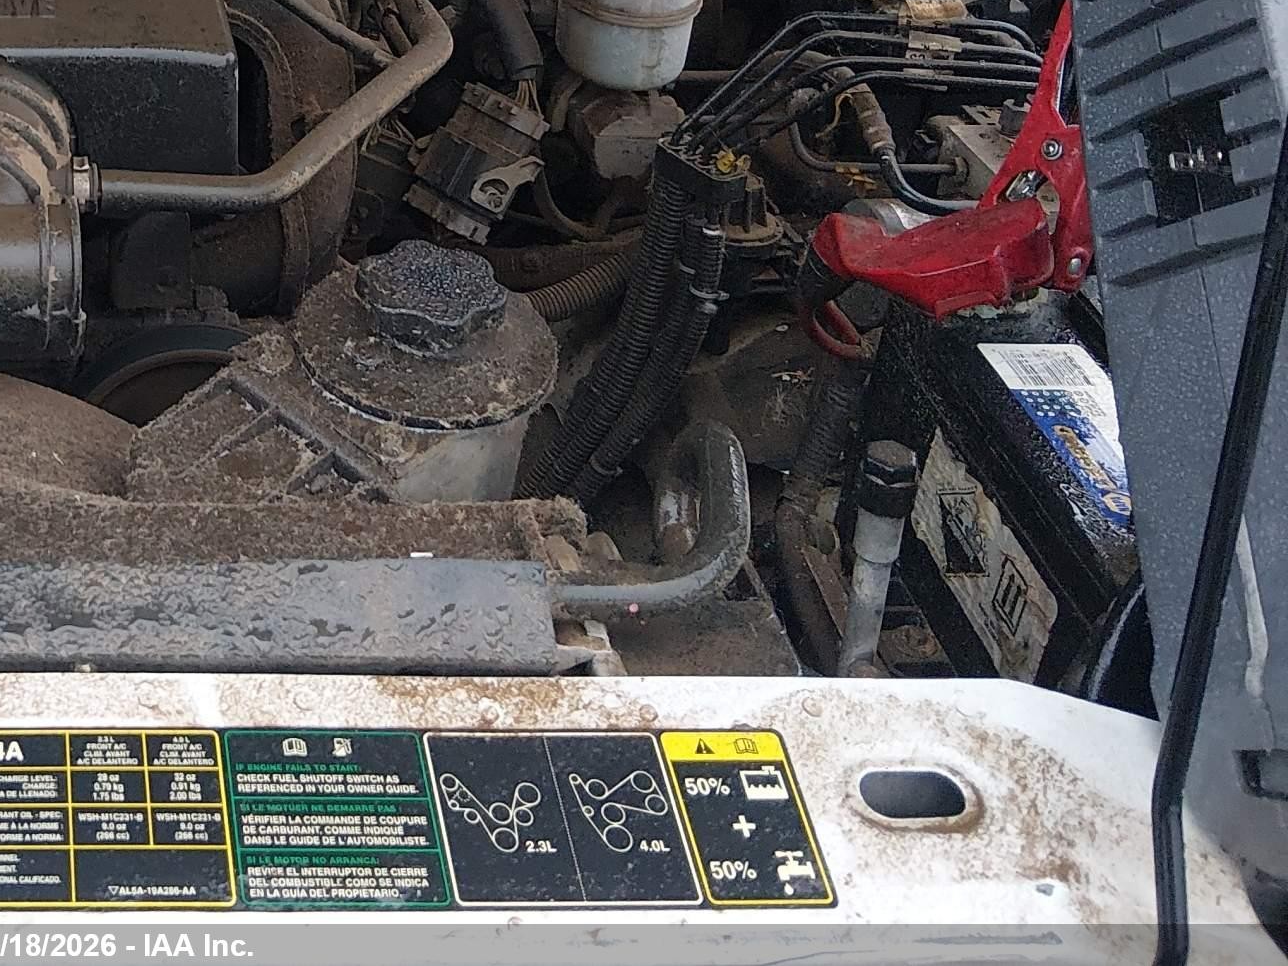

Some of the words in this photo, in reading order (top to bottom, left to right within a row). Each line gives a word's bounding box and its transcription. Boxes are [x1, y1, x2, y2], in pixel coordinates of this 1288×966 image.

[237, 774, 271, 782] CHECK
[273, 774, 298, 782] FUEL
[299, 774, 344, 783] SHUTOFF
[346, 775, 385, 783] SWITCH
[386, 775, 400, 784] AS
[238, 784, 304, 793] REFERENCED
[305, 784, 316, 793] IN
[317, 785, 345, 793] YOUR
[347, 785, 386, 793] OWNER
[386, 785, 419, 793] GUIDE.
[684, 777, 731, 796] 50%
[241, 813, 286, 824] VÉRIFIER
[288, 815, 302, 824] LA
[303, 815, 361, 824] COMMANDE
[363, 816, 377, 824] DE
[379, 816, 428, 825] COUPURE
[242, 825, 256, 834] DE
[324, 826, 362, 835] COMME
[243, 835, 272, 845] DANS
[273, 836, 287, 845] LE
[288, 836, 320, 845] GUIDE
[321, 836, 336, 845] DE
[337, 836, 430, 846] L'AUTOMOBILISTE.
[525, 840, 557, 852] 2.3L
[640, 840, 670, 852] 4.0L
[286, 867, 299, 876] EL
[300, 867, 372, 876] INTERRUPTOR
[374, 867, 389, 876] DE
[390, 868, 429, 877] CIERRE
[709, 861, 758, 881] 50%
[248, 877, 269, 887] DEL
[271, 877, 344, 887] COMBUSTIBLE
[345, 878, 377, 887] COMO
[378, 878, 393, 887] SE
[394, 878, 429, 887] INDICA
[249, 888, 265, 898] EN
[266, 888, 281, 898] LA
[309, 888, 330, 898] DEL
